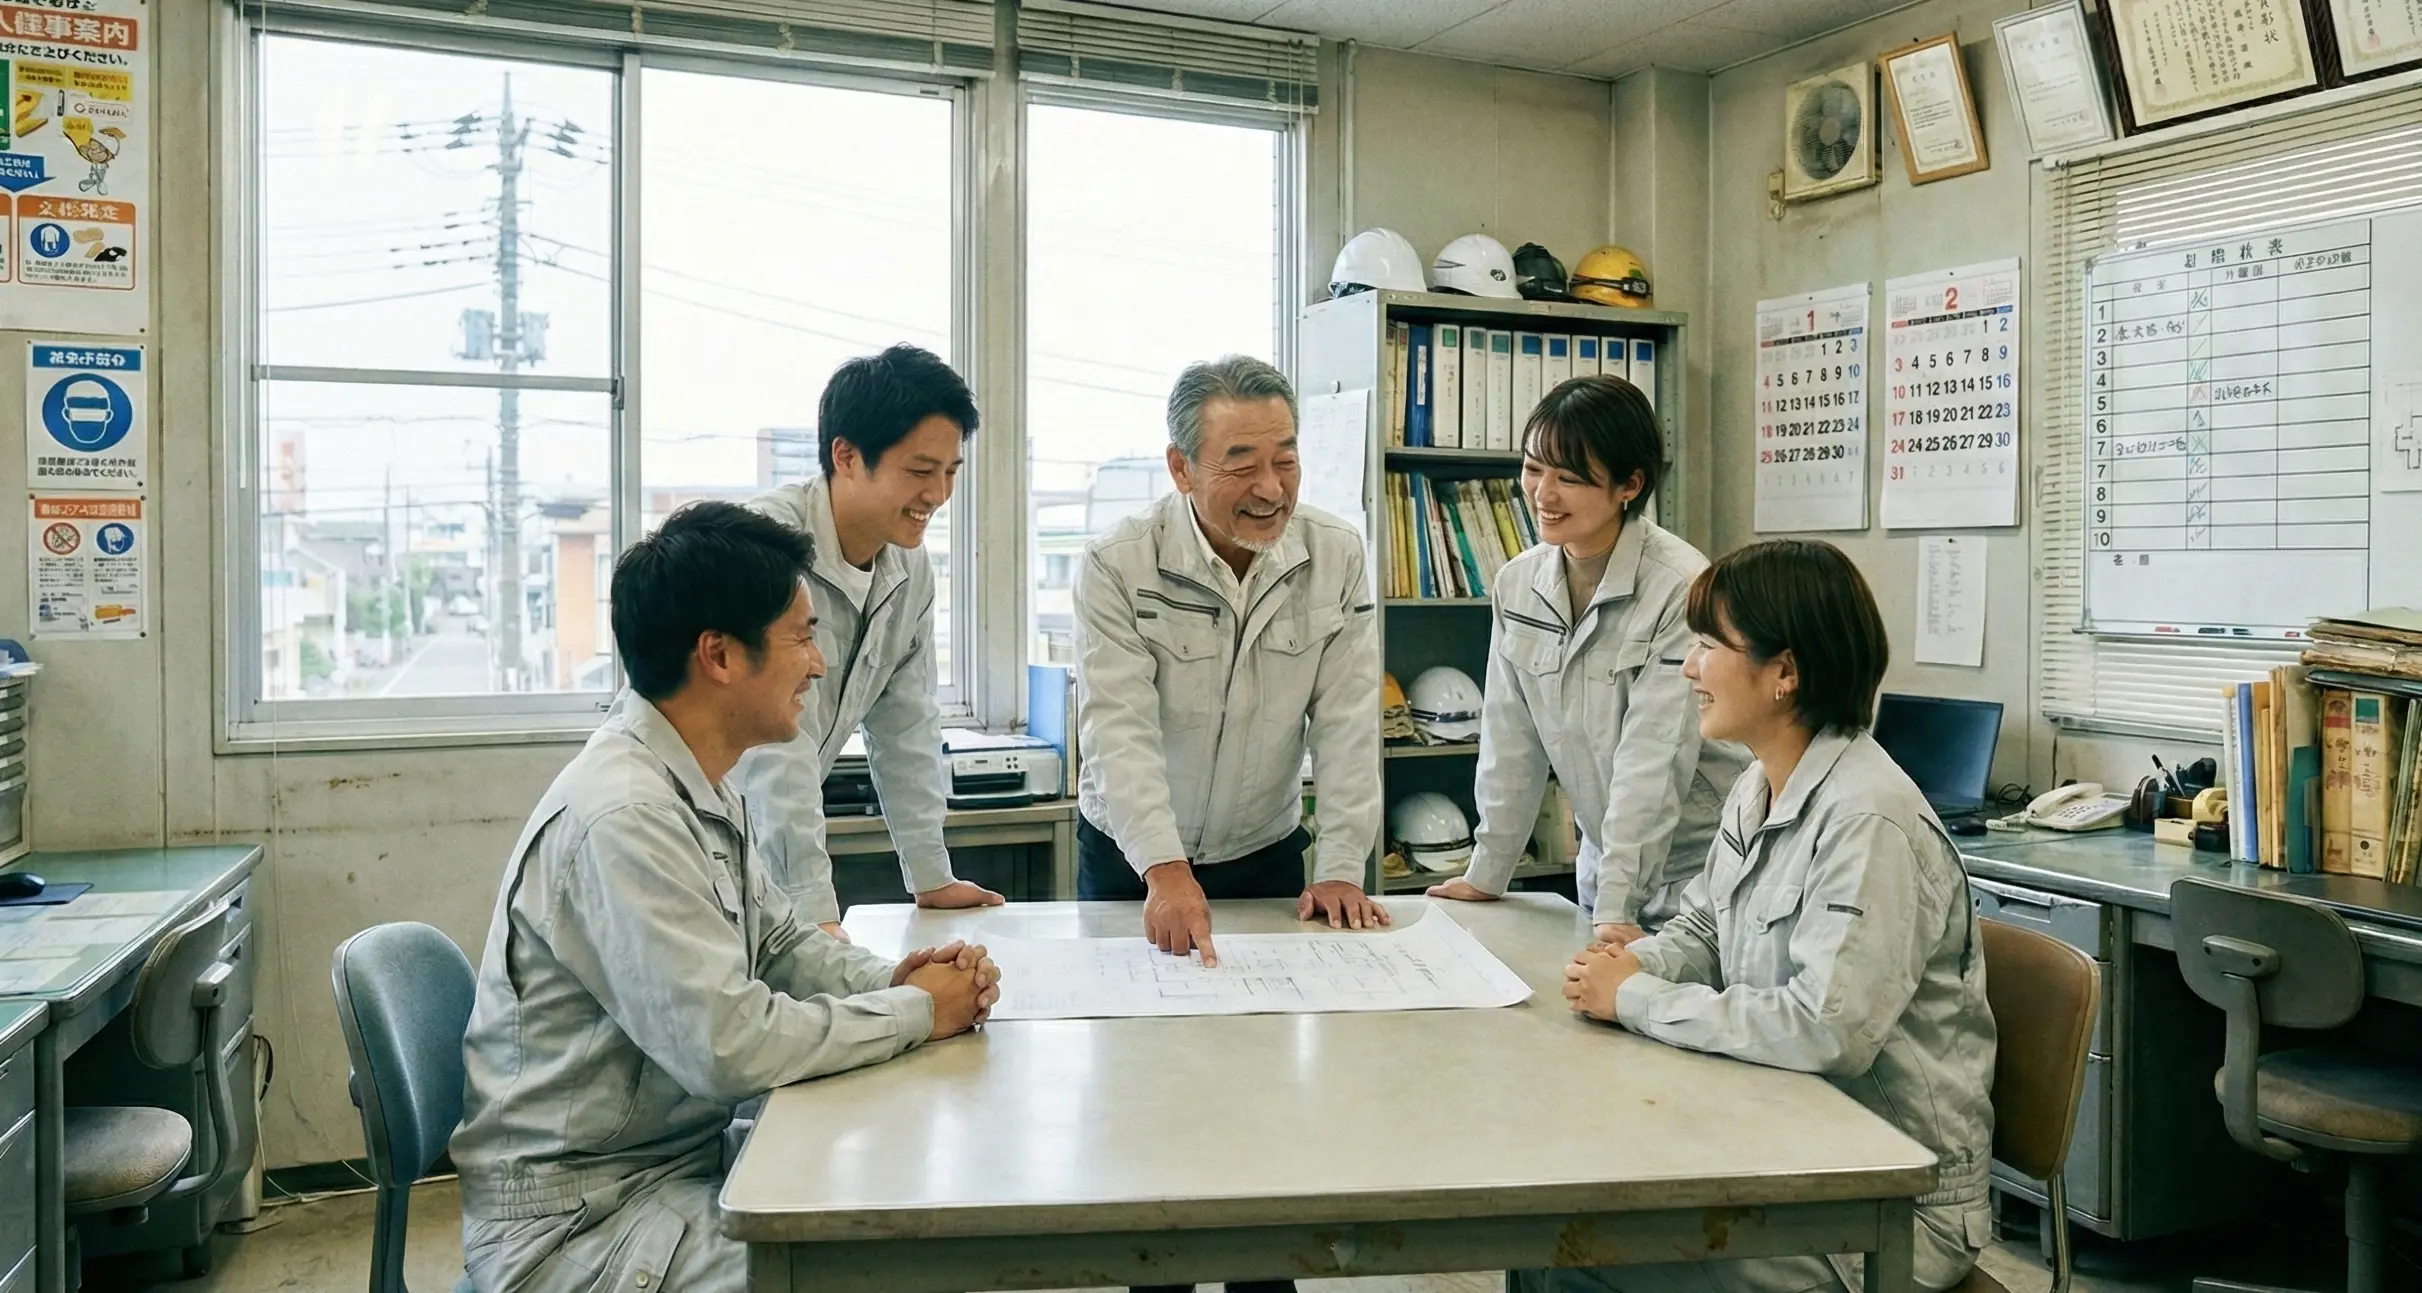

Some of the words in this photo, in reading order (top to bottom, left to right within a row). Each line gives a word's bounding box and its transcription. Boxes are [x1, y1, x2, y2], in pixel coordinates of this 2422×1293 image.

[1945, 287, 1958, 310] 2
[2099, 305, 2105, 320] 1
[1807, 310, 1815, 331] 1
[1984, 319, 1987, 333] 1
[2000, 317, 2008, 332] 2
[2097, 328, 2106, 343] 2
[1822, 343, 1826, 355] 1
[1836, 340, 1842, 354] 2
[1850, 338, 1857, 352] 3
[1895, 358, 1903, 372] 3
[1911, 355, 1919, 369] 4
[1929, 354, 1936, 368] 5
[1946, 352, 1954, 366] 6
[1964, 349, 1971, 364] 7
[1982, 347, 1989, 362] 8
[2000, 345, 2007, 360] 9
[2096, 350, 2107, 365] 3
[1764, 376, 1770, 389] 4
[1777, 373, 1784, 387] 5
[1791, 372, 1798, 385] 6
[1806, 370, 1812, 383] 7
[1820, 368, 1827, 381] 8
[1835, 366, 1842, 380] 9
[1848, 364, 1860, 378] 10
[2096, 373, 2106, 387] 4
[1893, 385, 1906, 399] 10
[1910, 384, 1921, 398] 11
[1926, 382, 1940, 396] 12
[1944, 379, 1957, 394] 13
[1961, 378, 1974, 392] 14
[1979, 375, 1993, 391] 15
[1996, 373, 2011, 388] 16
[1762, 400, 1772, 413] 11
[1776, 399, 1787, 412] 12
[1790, 398, 1801, 410] 13
[1804, 396, 1815, 409] 14
[1819, 394, 1830, 408] 15
[1833, 392, 1845, 406] 16
[1848, 391, 1859, 404] 17
[2097, 396, 2106, 411] 5
[1893, 411, 1906, 426] 17
[1909, 410, 1923, 425] 18
[1926, 409, 1940, 423] 19
[1943, 407, 1957, 422] 20
[1961, 406, 1974, 421] 21
[1978, 404, 1992, 420] 22
[1995, 402, 2010, 418] 23
[1762, 425, 1772, 438] 18
[1776, 424, 1787, 437] 19
[1789, 423, 1801, 436] 20
[1803, 422, 1814, 435] 21
[1817, 420, 1830, 434] 22
[1832, 418, 1845, 432] 23
[1847, 417, 1859, 431] 24
[2096, 419, 2107, 433] 6
[1891, 439, 1905, 453] 24
[1908, 438, 1922, 452] 24
[1925, 437, 1940, 451] 25
[1942, 435, 1957, 451] 26
[1960, 434, 1974, 449] 27
[1977, 433, 1993, 448] 29
[1995, 432, 2010, 447] 30
[2097, 441, 2106, 456] 7
[1761, 450, 1772, 464] 25
[1788, 448, 1801, 462] 27
[1802, 447, 1815, 461] 28
[1832, 445, 1845, 459] 30
[1891, 466, 1904, 480] 31
[1928, 465, 1935, 477] 2
[2097, 464, 2106, 478] 7
[2096, 487, 2106, 501] 8
[2097, 509, 2106, 523] 9
[2094, 532, 2110, 546] 10
